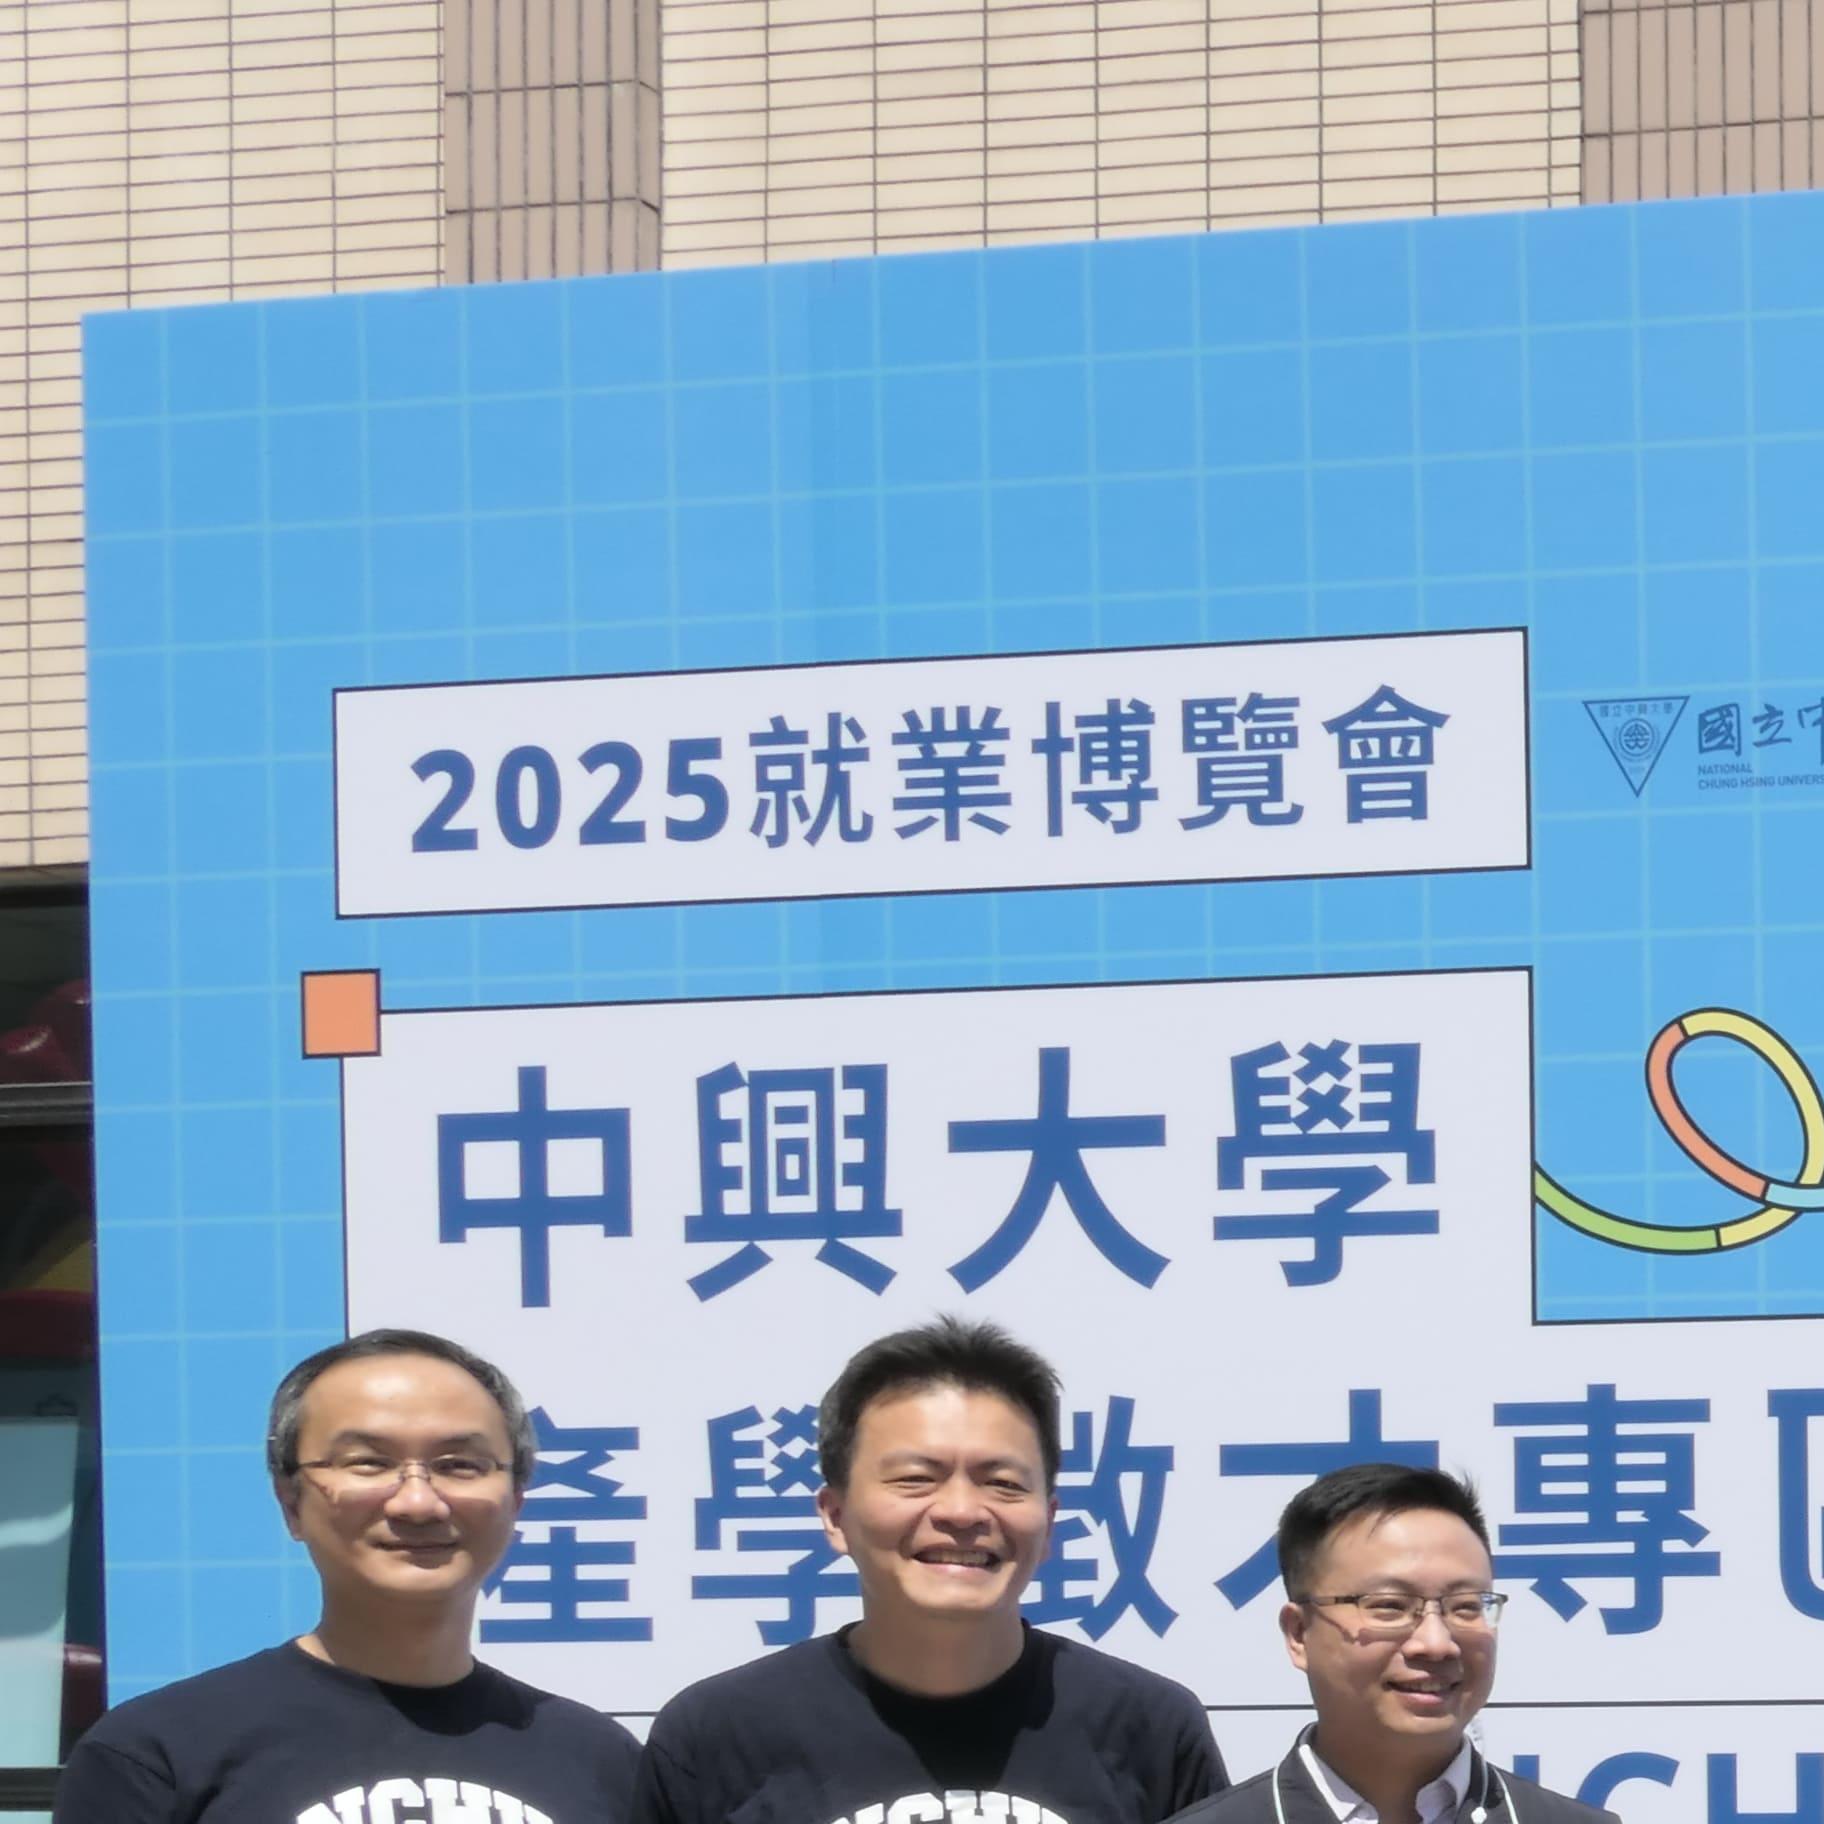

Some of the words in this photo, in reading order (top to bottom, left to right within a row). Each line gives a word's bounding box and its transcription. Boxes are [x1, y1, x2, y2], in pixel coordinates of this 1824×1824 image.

[408, 684, 1451, 854] 2025就業博覽會
[1697, 762, 1753, 776] NATIONAL
[1697, 777, 1738, 790] CHUNG
[1740, 775, 1776, 789] HSING
[436, 1039, 1441, 1309] 中興大學
